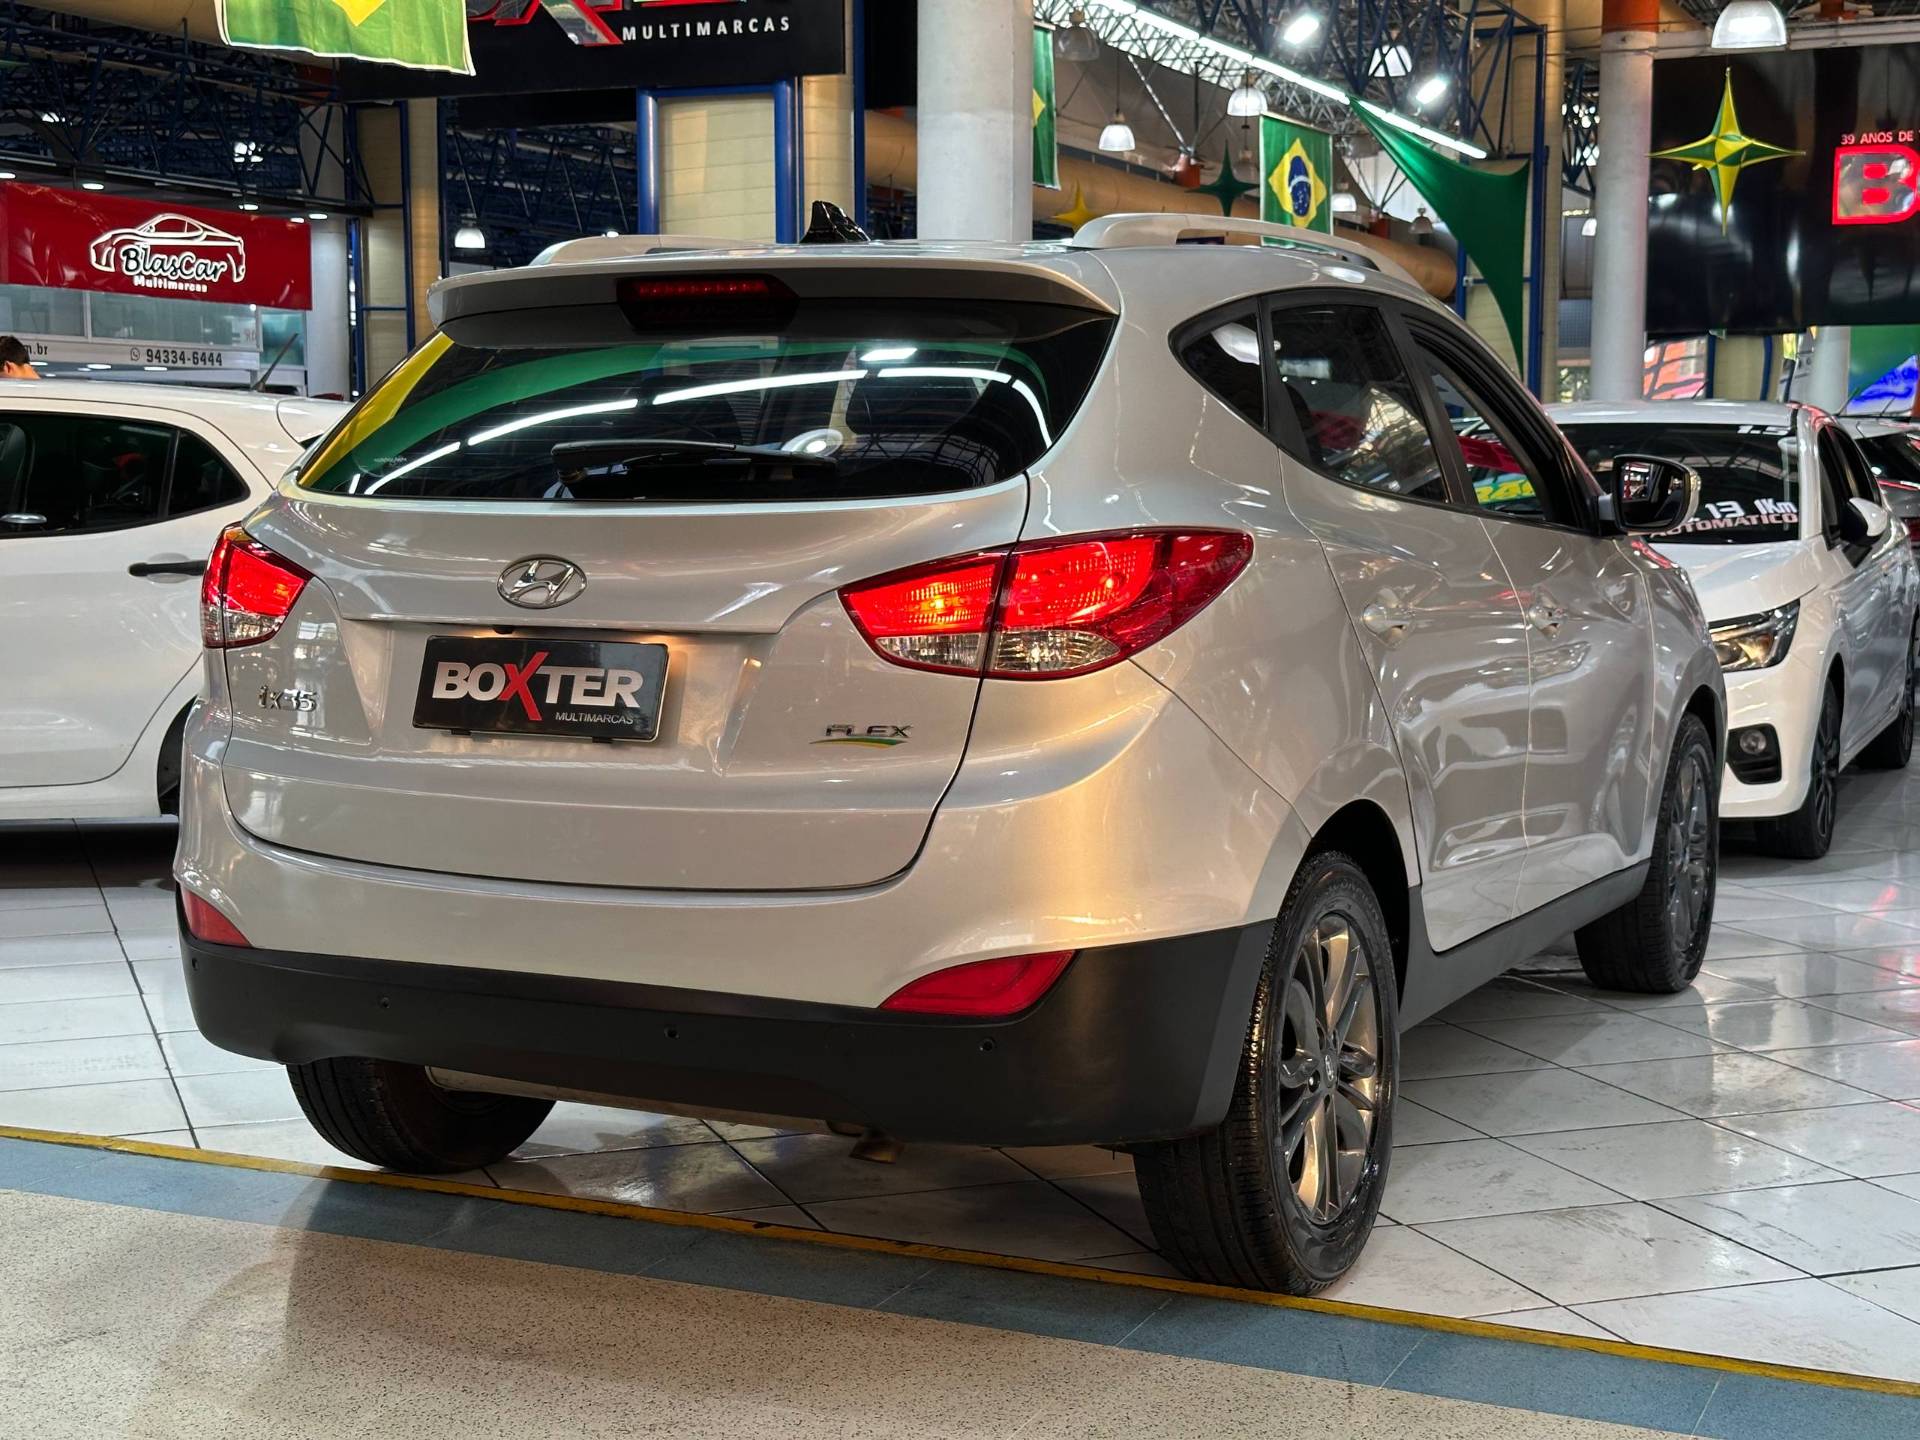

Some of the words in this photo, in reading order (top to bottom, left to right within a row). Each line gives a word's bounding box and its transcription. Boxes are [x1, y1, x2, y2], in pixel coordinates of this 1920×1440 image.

[622, 16, 791, 42] MULTIMARCAS
[1841, 133, 1855, 144] 39
[1860, 132, 1893, 143] ANOS
[1898, 130, 1914, 142] DE
[1832, 145, 1920, 225] B
[121, 243, 227, 282] BlasCar
[133, 275, 208, 292] Multimarcas
[146, 349, 223, 366] 94334-6444
[432, 651, 644, 721] BOXTER
[555, 711, 634, 725] MULTIMARCAS
[826, 724, 914, 738] FLEX
